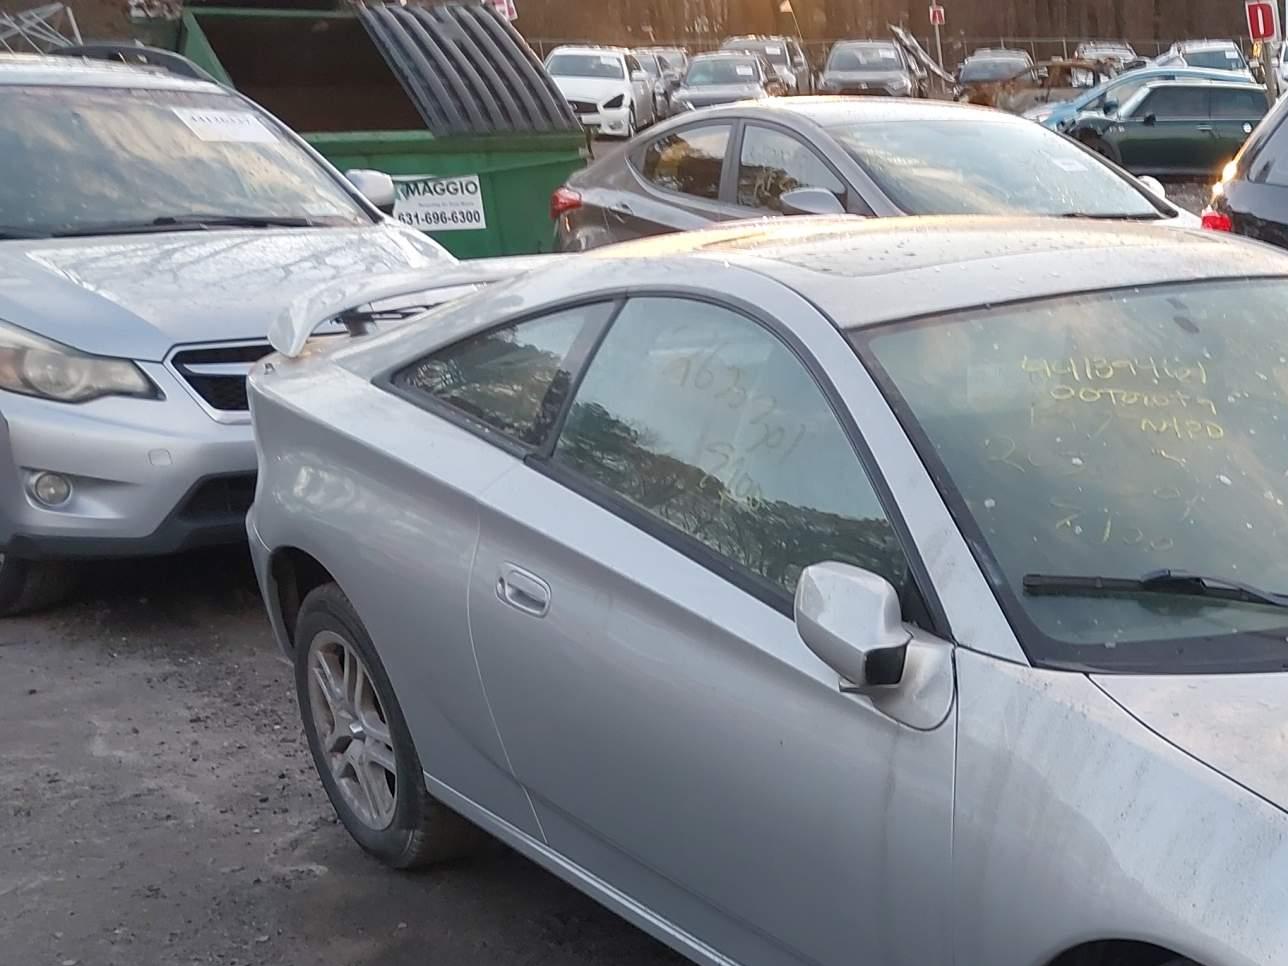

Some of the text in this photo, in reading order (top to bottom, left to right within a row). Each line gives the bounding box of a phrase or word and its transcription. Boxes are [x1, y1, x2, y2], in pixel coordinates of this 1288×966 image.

[1247, 3, 1275, 39] D
[405, 180, 478, 197] MAGGIO
[398, 209, 481, 225] 631-696-6300
